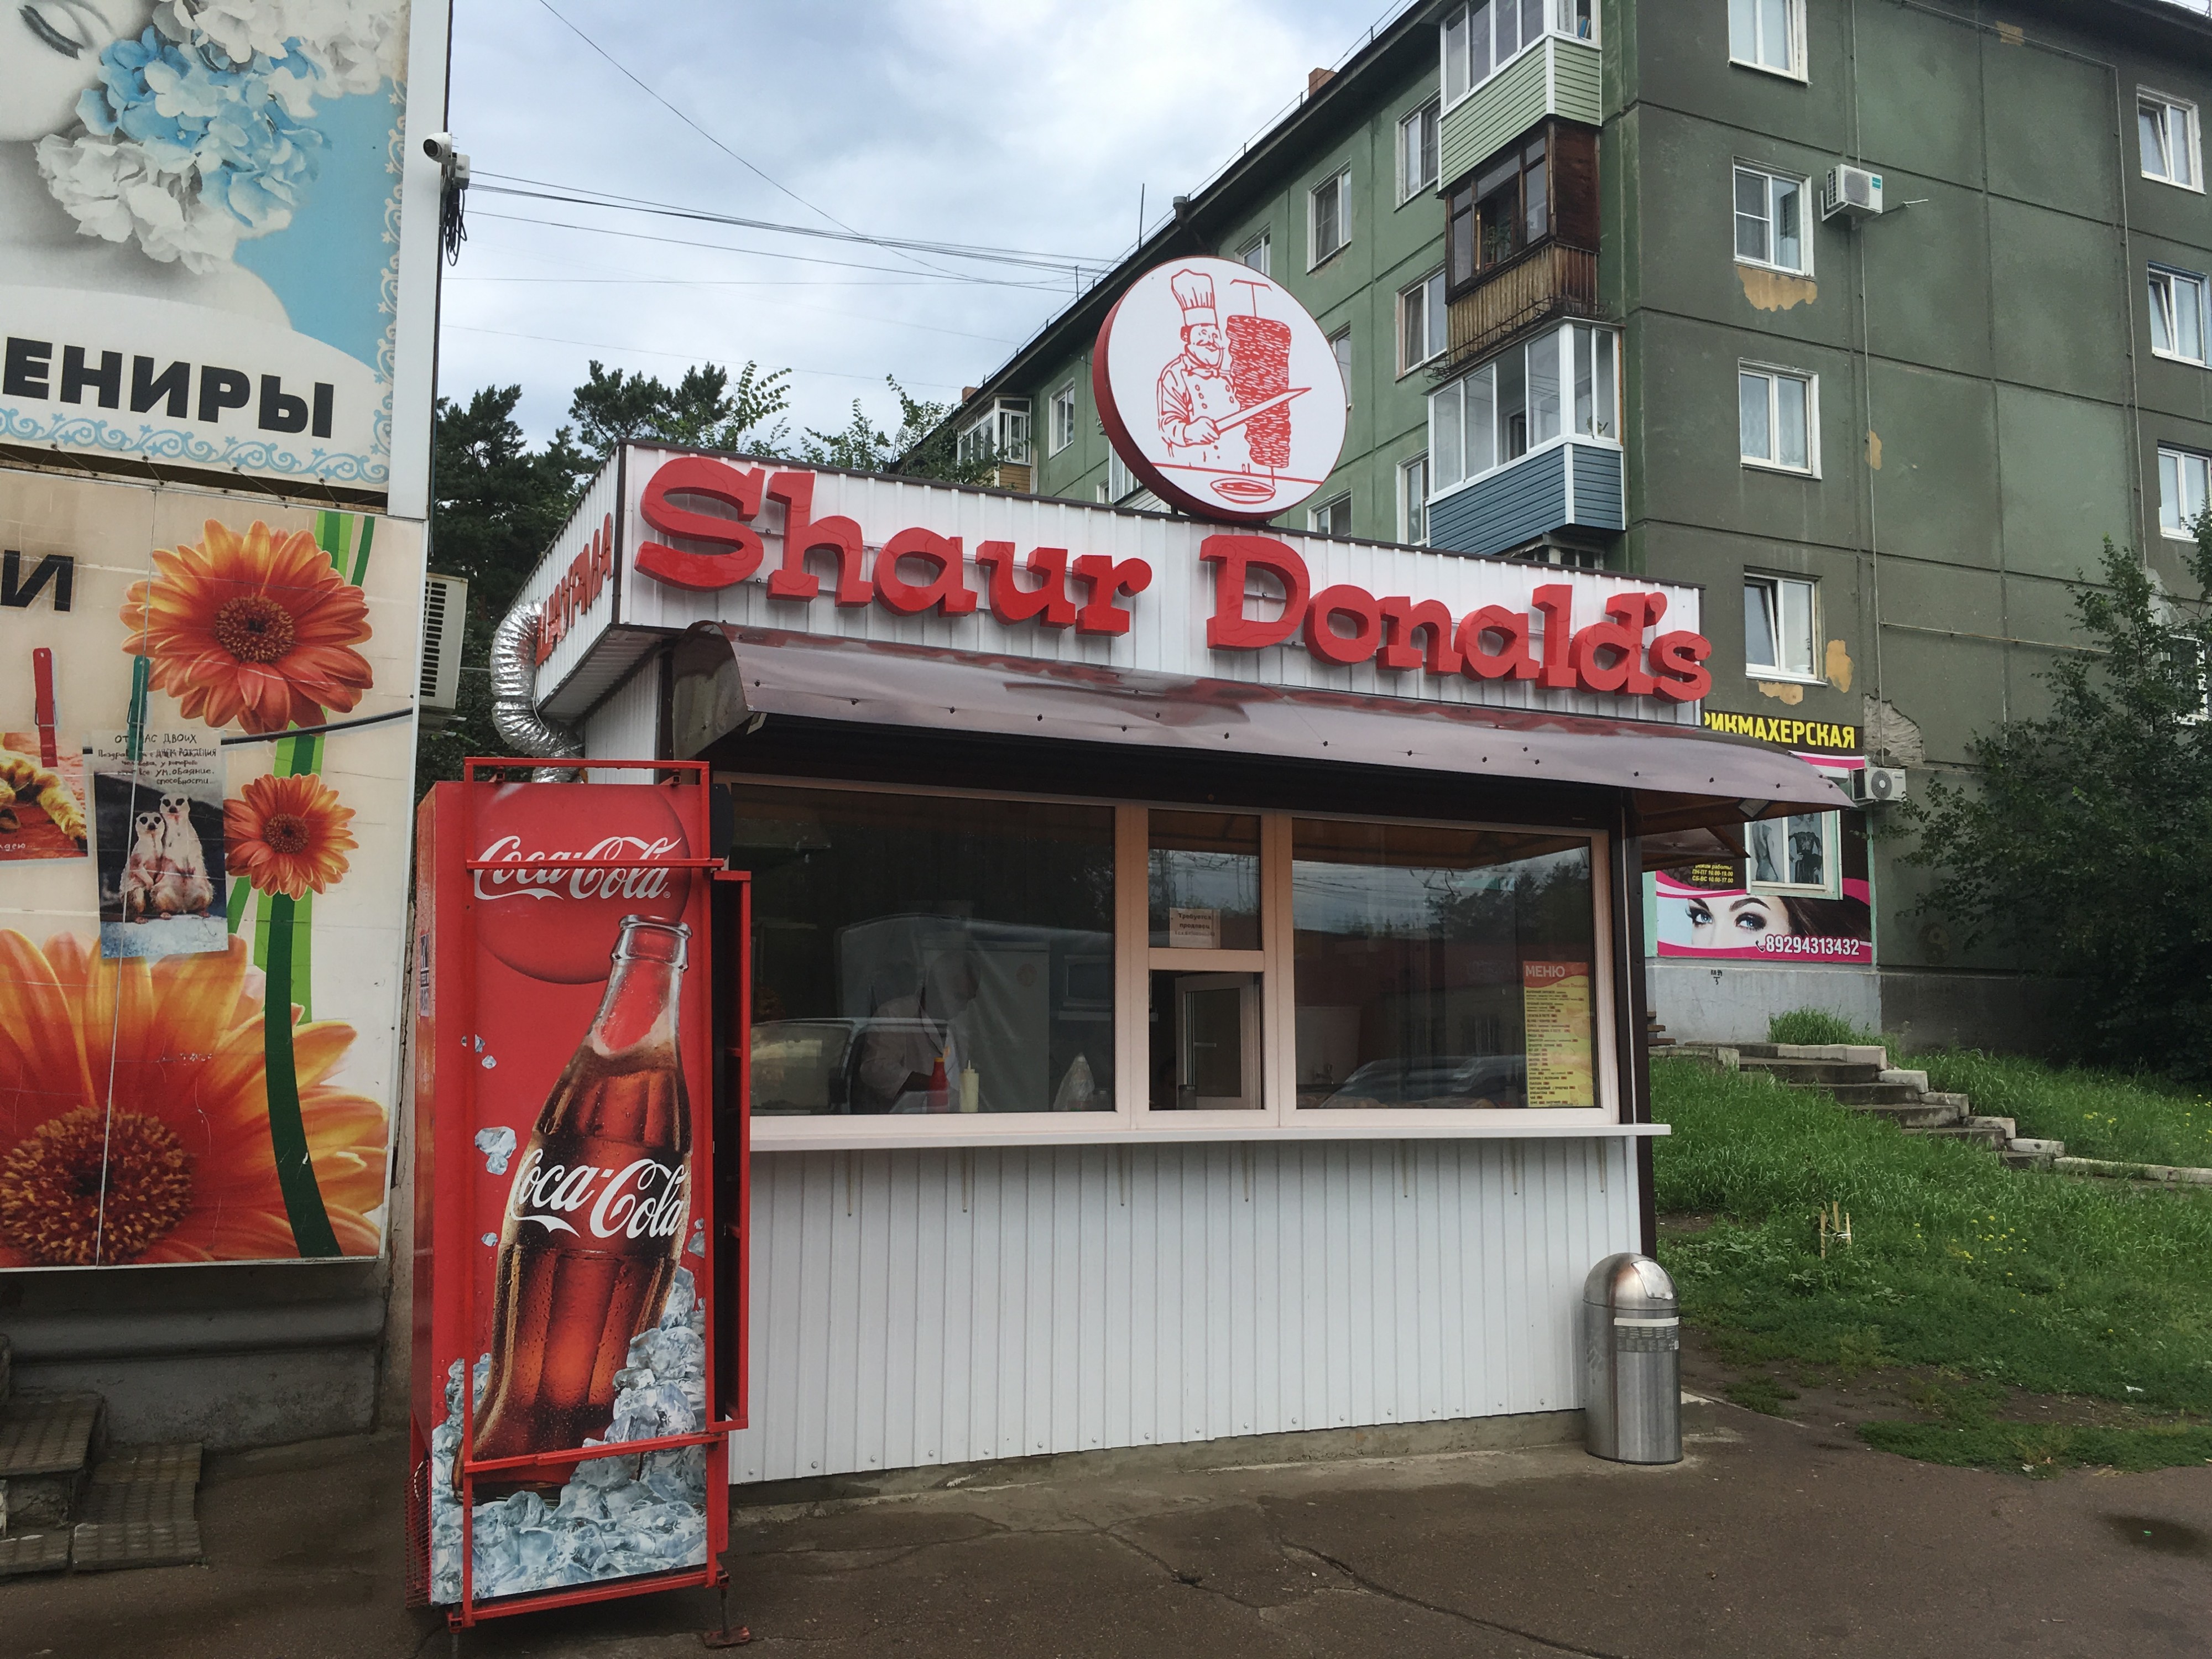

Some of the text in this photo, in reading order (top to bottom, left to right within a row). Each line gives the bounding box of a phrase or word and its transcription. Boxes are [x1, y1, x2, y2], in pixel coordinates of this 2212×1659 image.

[2, 337, 333, 439] ЕНИРЫ
[634, 456, 1712, 704] Shaur Donald's
[163, 733, 197, 744] ДВОИХ
[474, 835, 682, 900] Coca-Cola
[1178, 912, 1212, 921] Требуется
[1766, 935, 1860, 956] 89294313432
[1525, 965, 1566, 978] МЕНЮ
[509, 1147, 686, 1239] Coca-Cola
